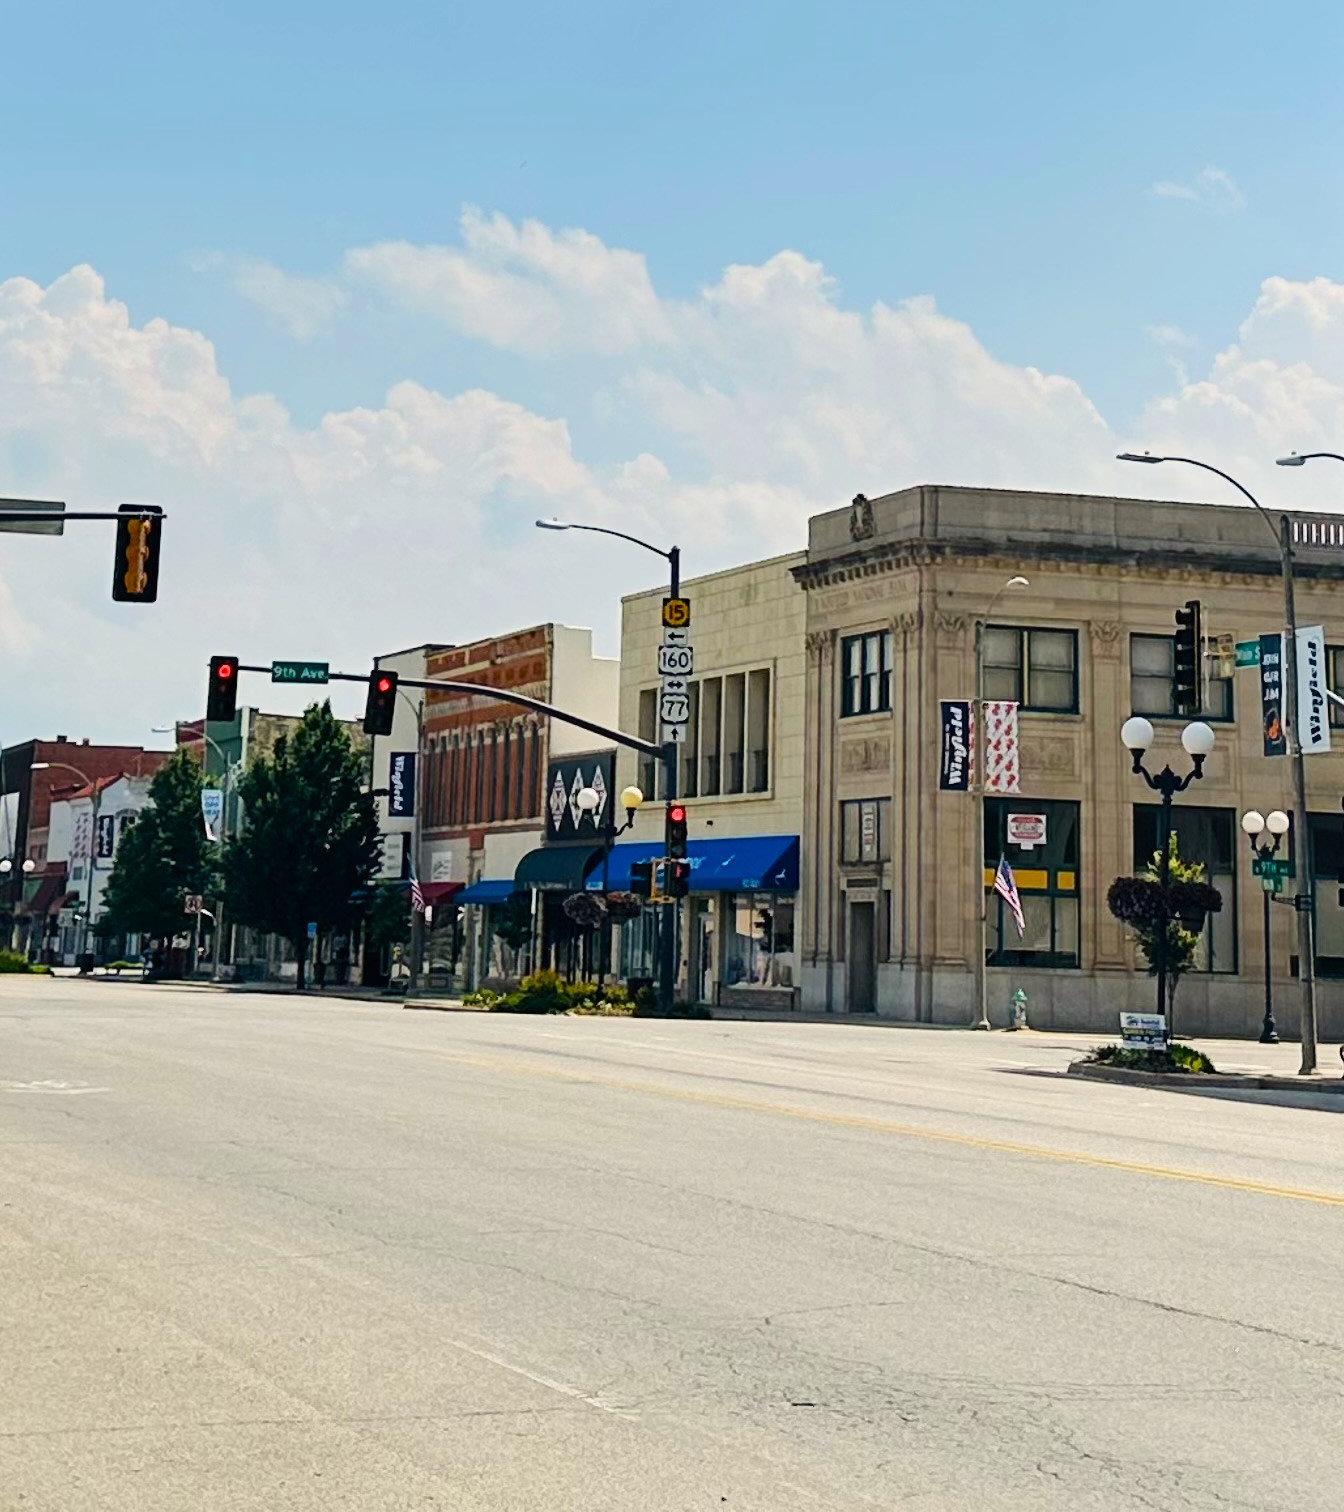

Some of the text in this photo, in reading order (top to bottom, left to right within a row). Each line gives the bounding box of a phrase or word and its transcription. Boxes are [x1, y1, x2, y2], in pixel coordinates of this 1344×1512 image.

[669, 604, 685, 620] 15
[662, 651, 689, 668] 160
[273, 666, 296, 678] 9th
[665, 700, 685, 716] 77
[949, 706, 967, 785] Winfield
